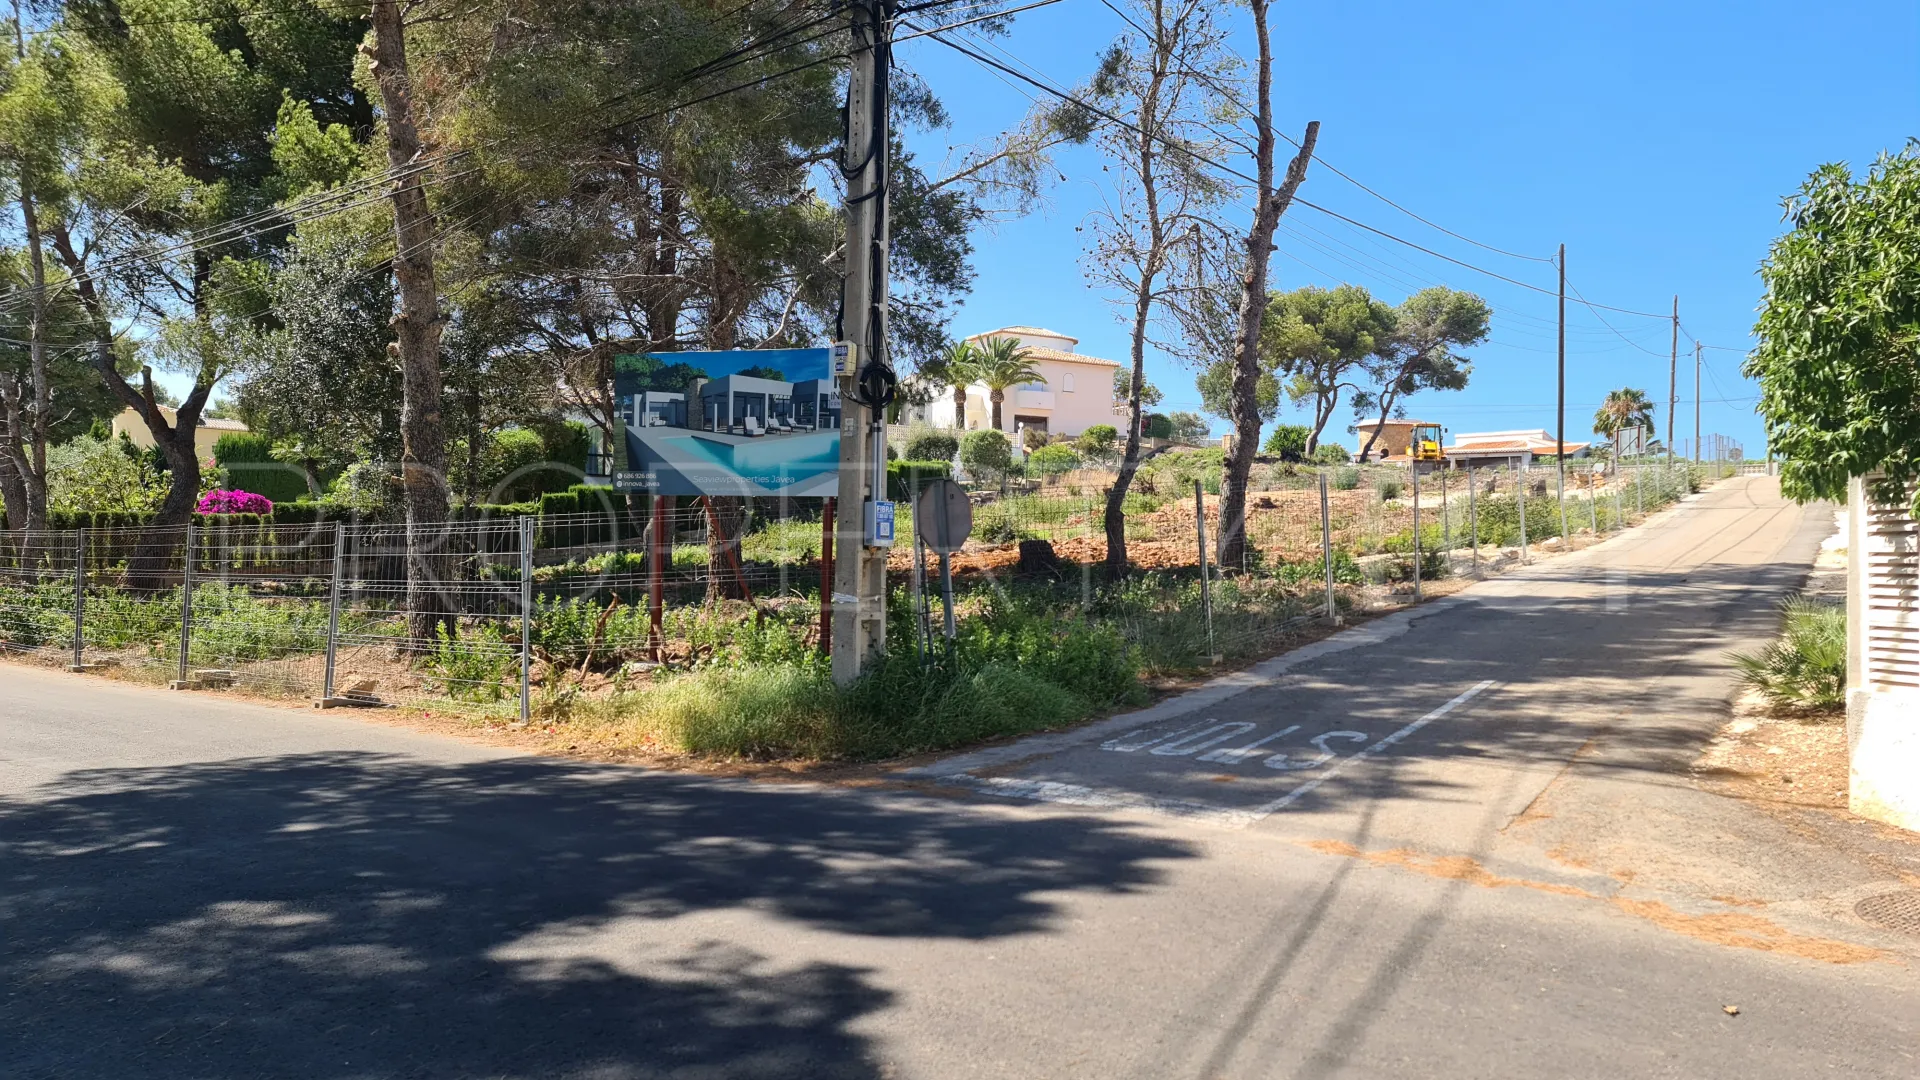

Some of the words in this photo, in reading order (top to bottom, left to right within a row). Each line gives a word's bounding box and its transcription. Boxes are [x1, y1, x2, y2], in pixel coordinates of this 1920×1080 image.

[692, 475, 769, 485] Seaviewproperties
[771, 474, 795, 483] Javea
[876, 505, 894, 513] FIBRA
[1098, 718, 1368, 771] STOP
